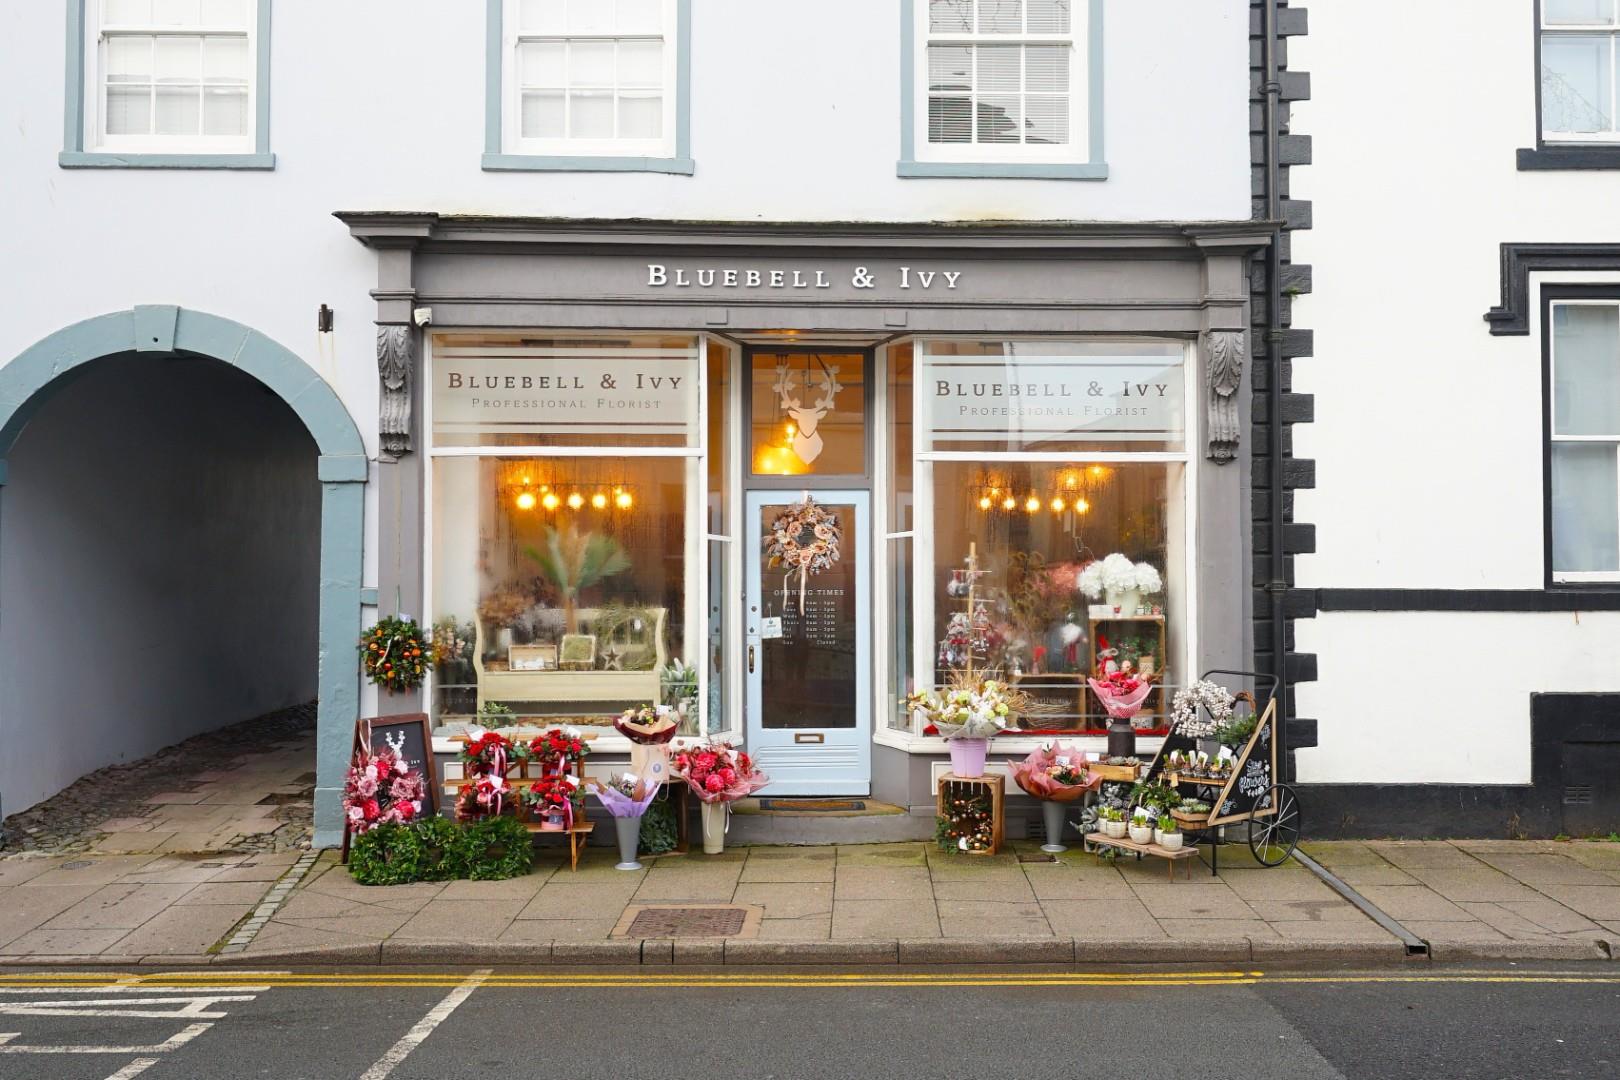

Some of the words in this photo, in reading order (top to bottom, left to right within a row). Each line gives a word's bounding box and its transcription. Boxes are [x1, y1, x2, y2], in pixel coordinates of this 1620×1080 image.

[647, 264, 830, 289] BLUEBELL
[852, 266, 875, 289] &
[899, 266, 961, 289] IVY
[447, 372, 584, 390] BLUEBELL
[600, 373, 617, 390] &
[635, 373, 682, 390] IVY
[936, 380, 1072, 397] BLUEBELL
[1087, 380, 1104, 397] &
[1122, 380, 1168, 397] IVY
[472, 398, 587, 409] PROFESSIONAL
[597, 398, 663, 409] FLORIST
[959, 405, 1073, 416] PROFESSIONAL
[1084, 405, 1149, 416] FLORIST
